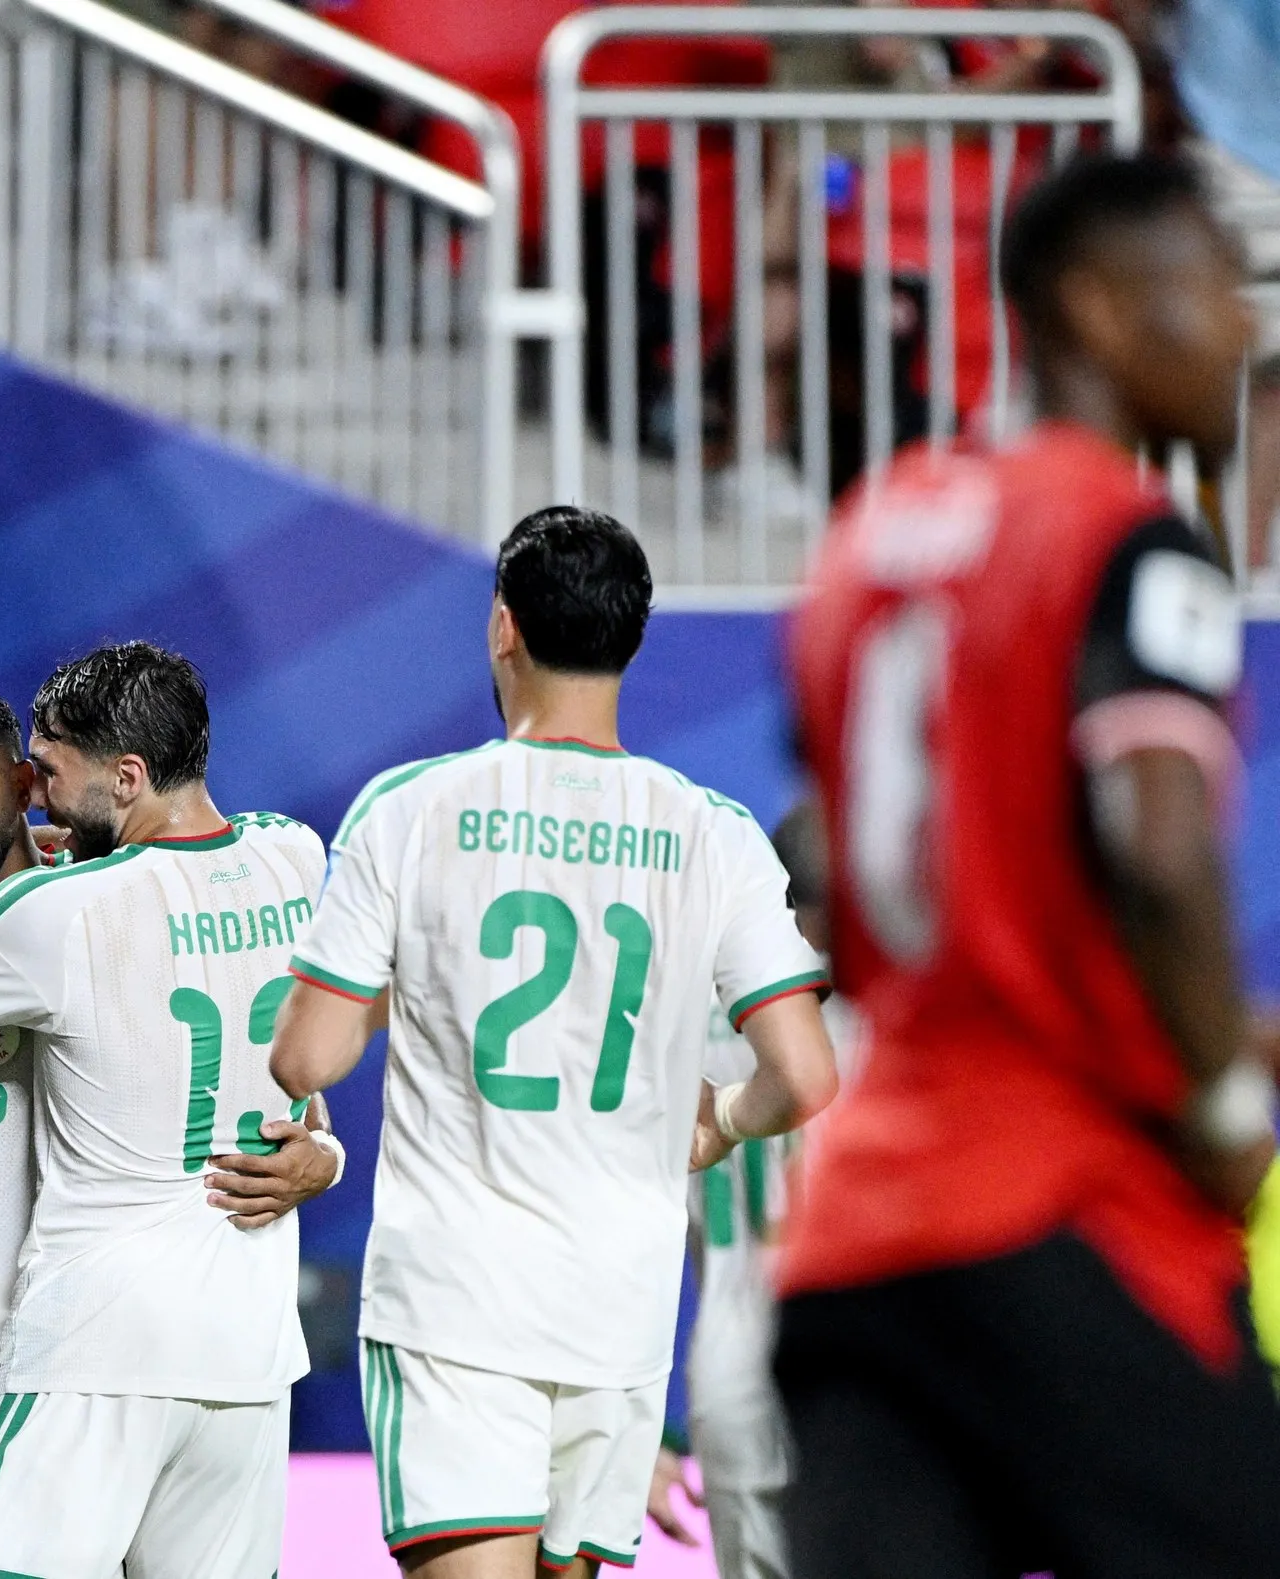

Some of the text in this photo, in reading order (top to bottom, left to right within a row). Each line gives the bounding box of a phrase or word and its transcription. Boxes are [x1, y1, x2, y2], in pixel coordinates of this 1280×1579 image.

[459, 809, 680, 873] BENSEBAINI
[168, 896, 313, 956] HADJAM
[473, 889, 653, 1112] 21
